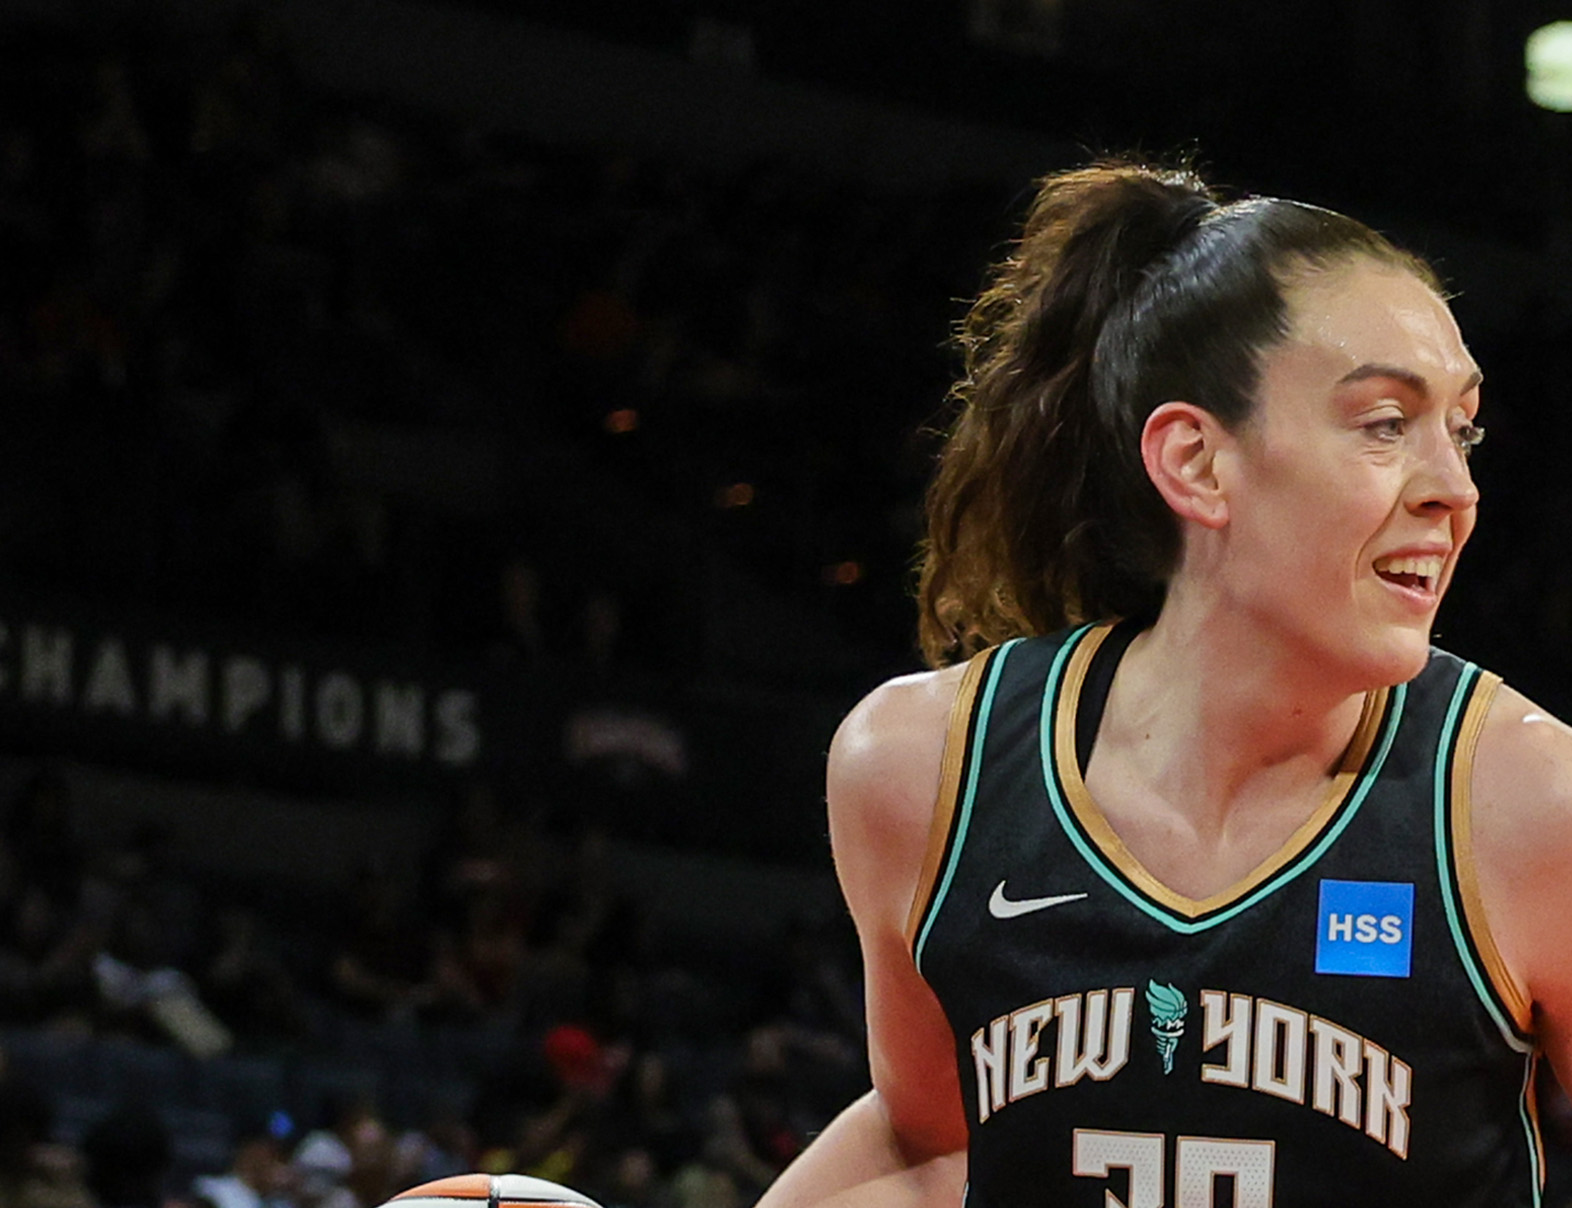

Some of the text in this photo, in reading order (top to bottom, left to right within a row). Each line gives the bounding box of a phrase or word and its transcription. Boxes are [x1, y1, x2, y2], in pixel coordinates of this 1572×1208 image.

[0, 621, 481, 765] HAMPIONS
[1326, 913, 1402, 944] HSS
[970, 986, 1413, 1161] NEW YORK
